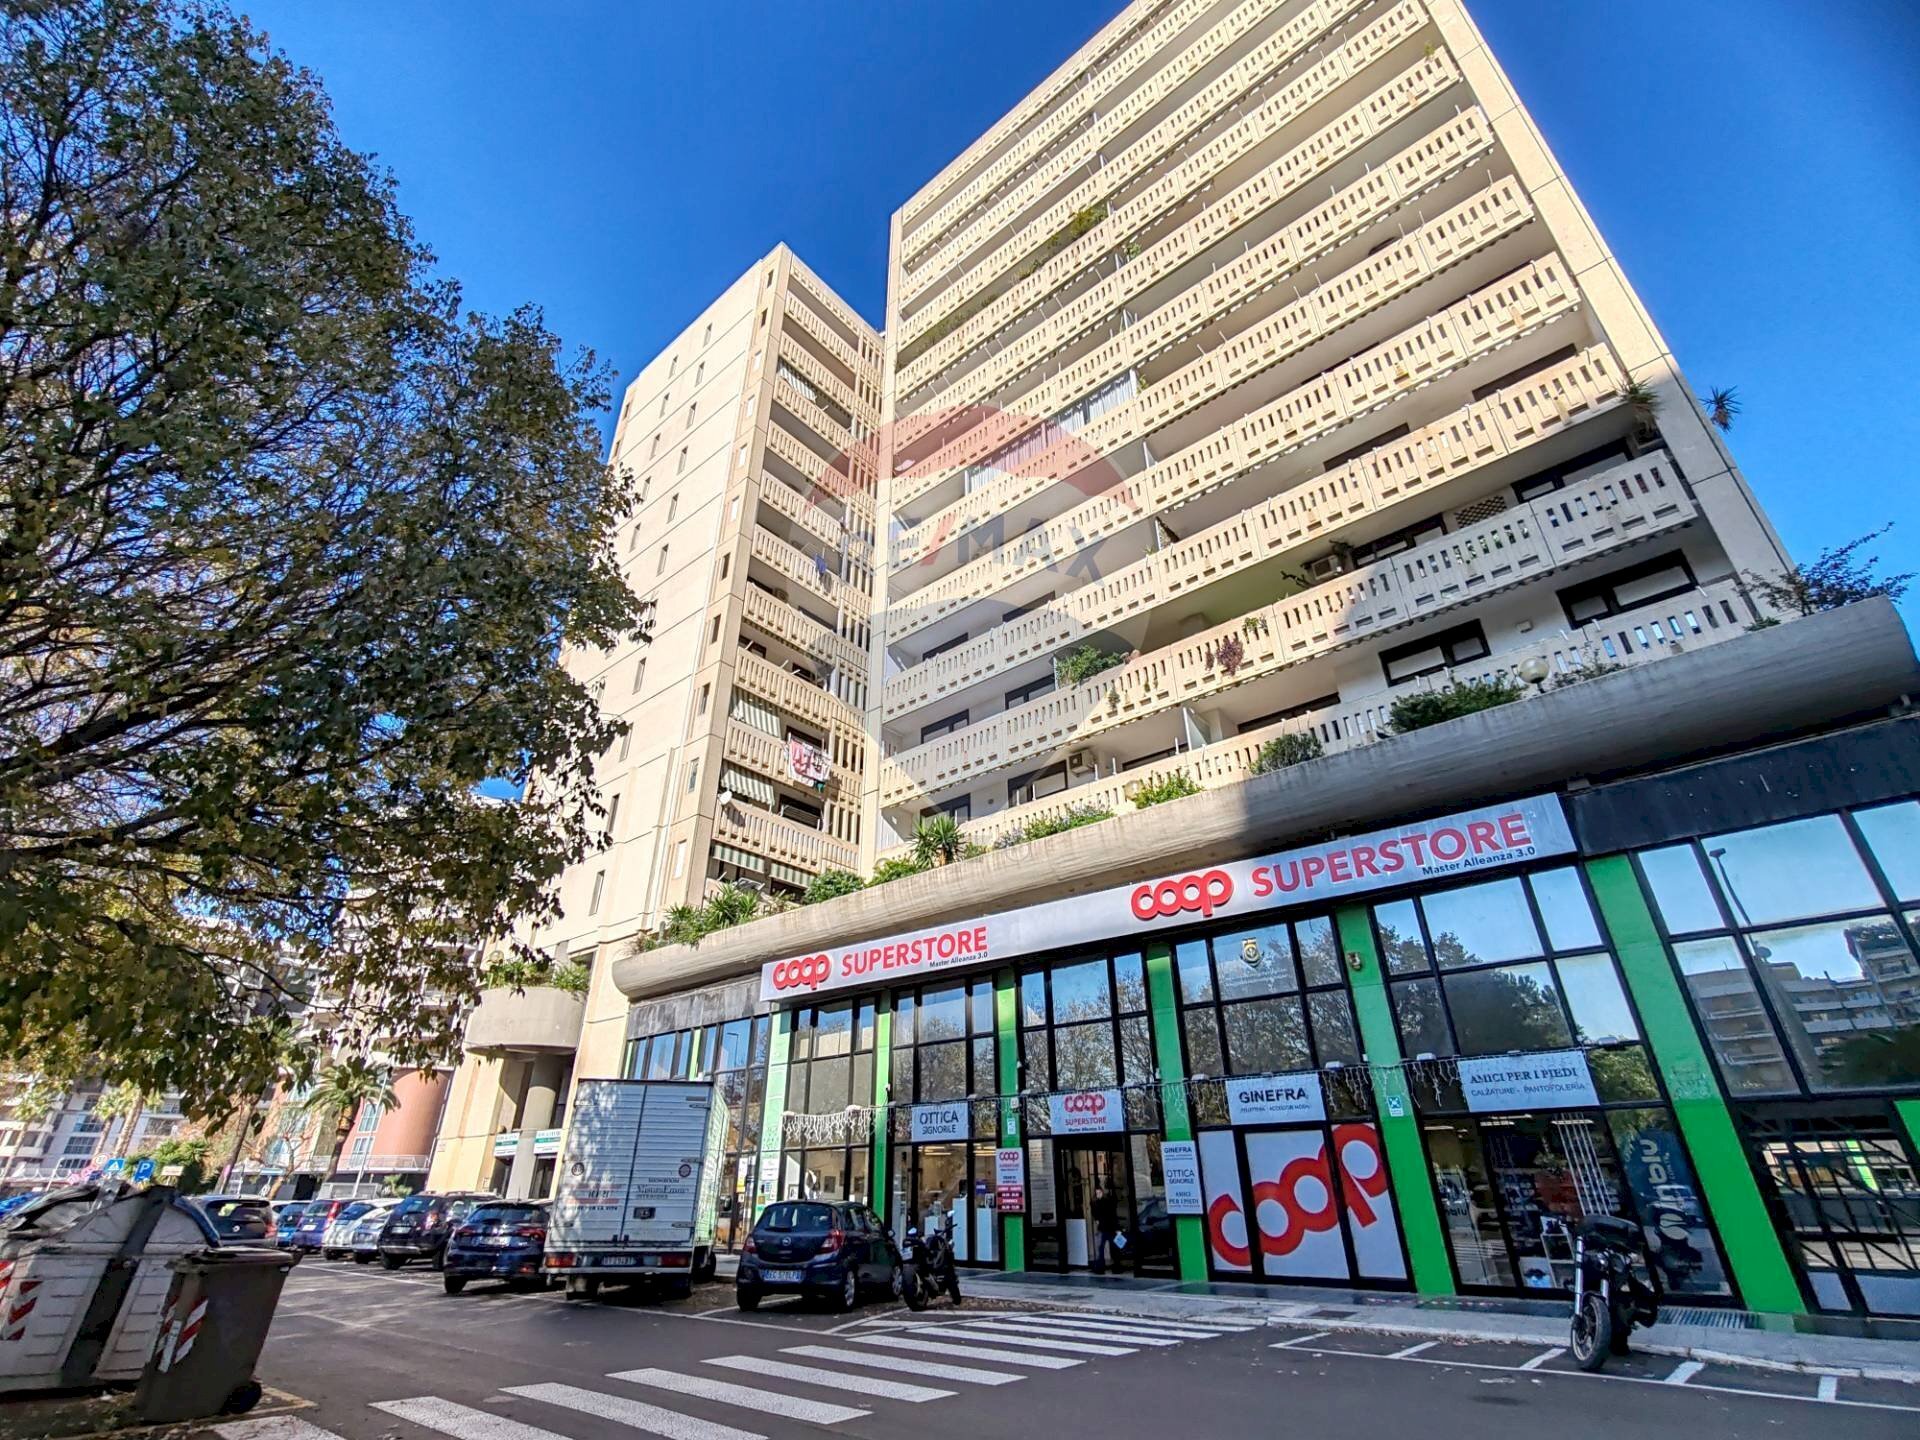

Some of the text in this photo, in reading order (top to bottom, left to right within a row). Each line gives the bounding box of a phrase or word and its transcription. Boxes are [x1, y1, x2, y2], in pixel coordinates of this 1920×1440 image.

[1131, 814, 1532, 920] coop SUPERSTORE
[1422, 847, 1536, 875] Master Alleanza 3.0
[772, 926, 988, 990] coop SUPERSTORE
[929, 951, 988, 968] Master Alleanza 3.0
[1470, 1067, 1578, 1084] AMICI PER I PIEDI
[1239, 1087, 1307, 1104] GINEFRA
[1471, 1087, 1515, 1097] CALZATURE
[1523, 1083, 1585, 1094] PANTOFOLERIA
[919, 1110, 959, 1125] OTTICA
[1065, 1117, 1107, 1126] SUPERSTORE
[922, 1124, 956, 1135] SIGNORILE
[1163, 1146, 1192, 1154] GINEFRA
[1166, 1169, 1195, 1178] OTTICA
[1209, 1123, 1389, 1267] coop
